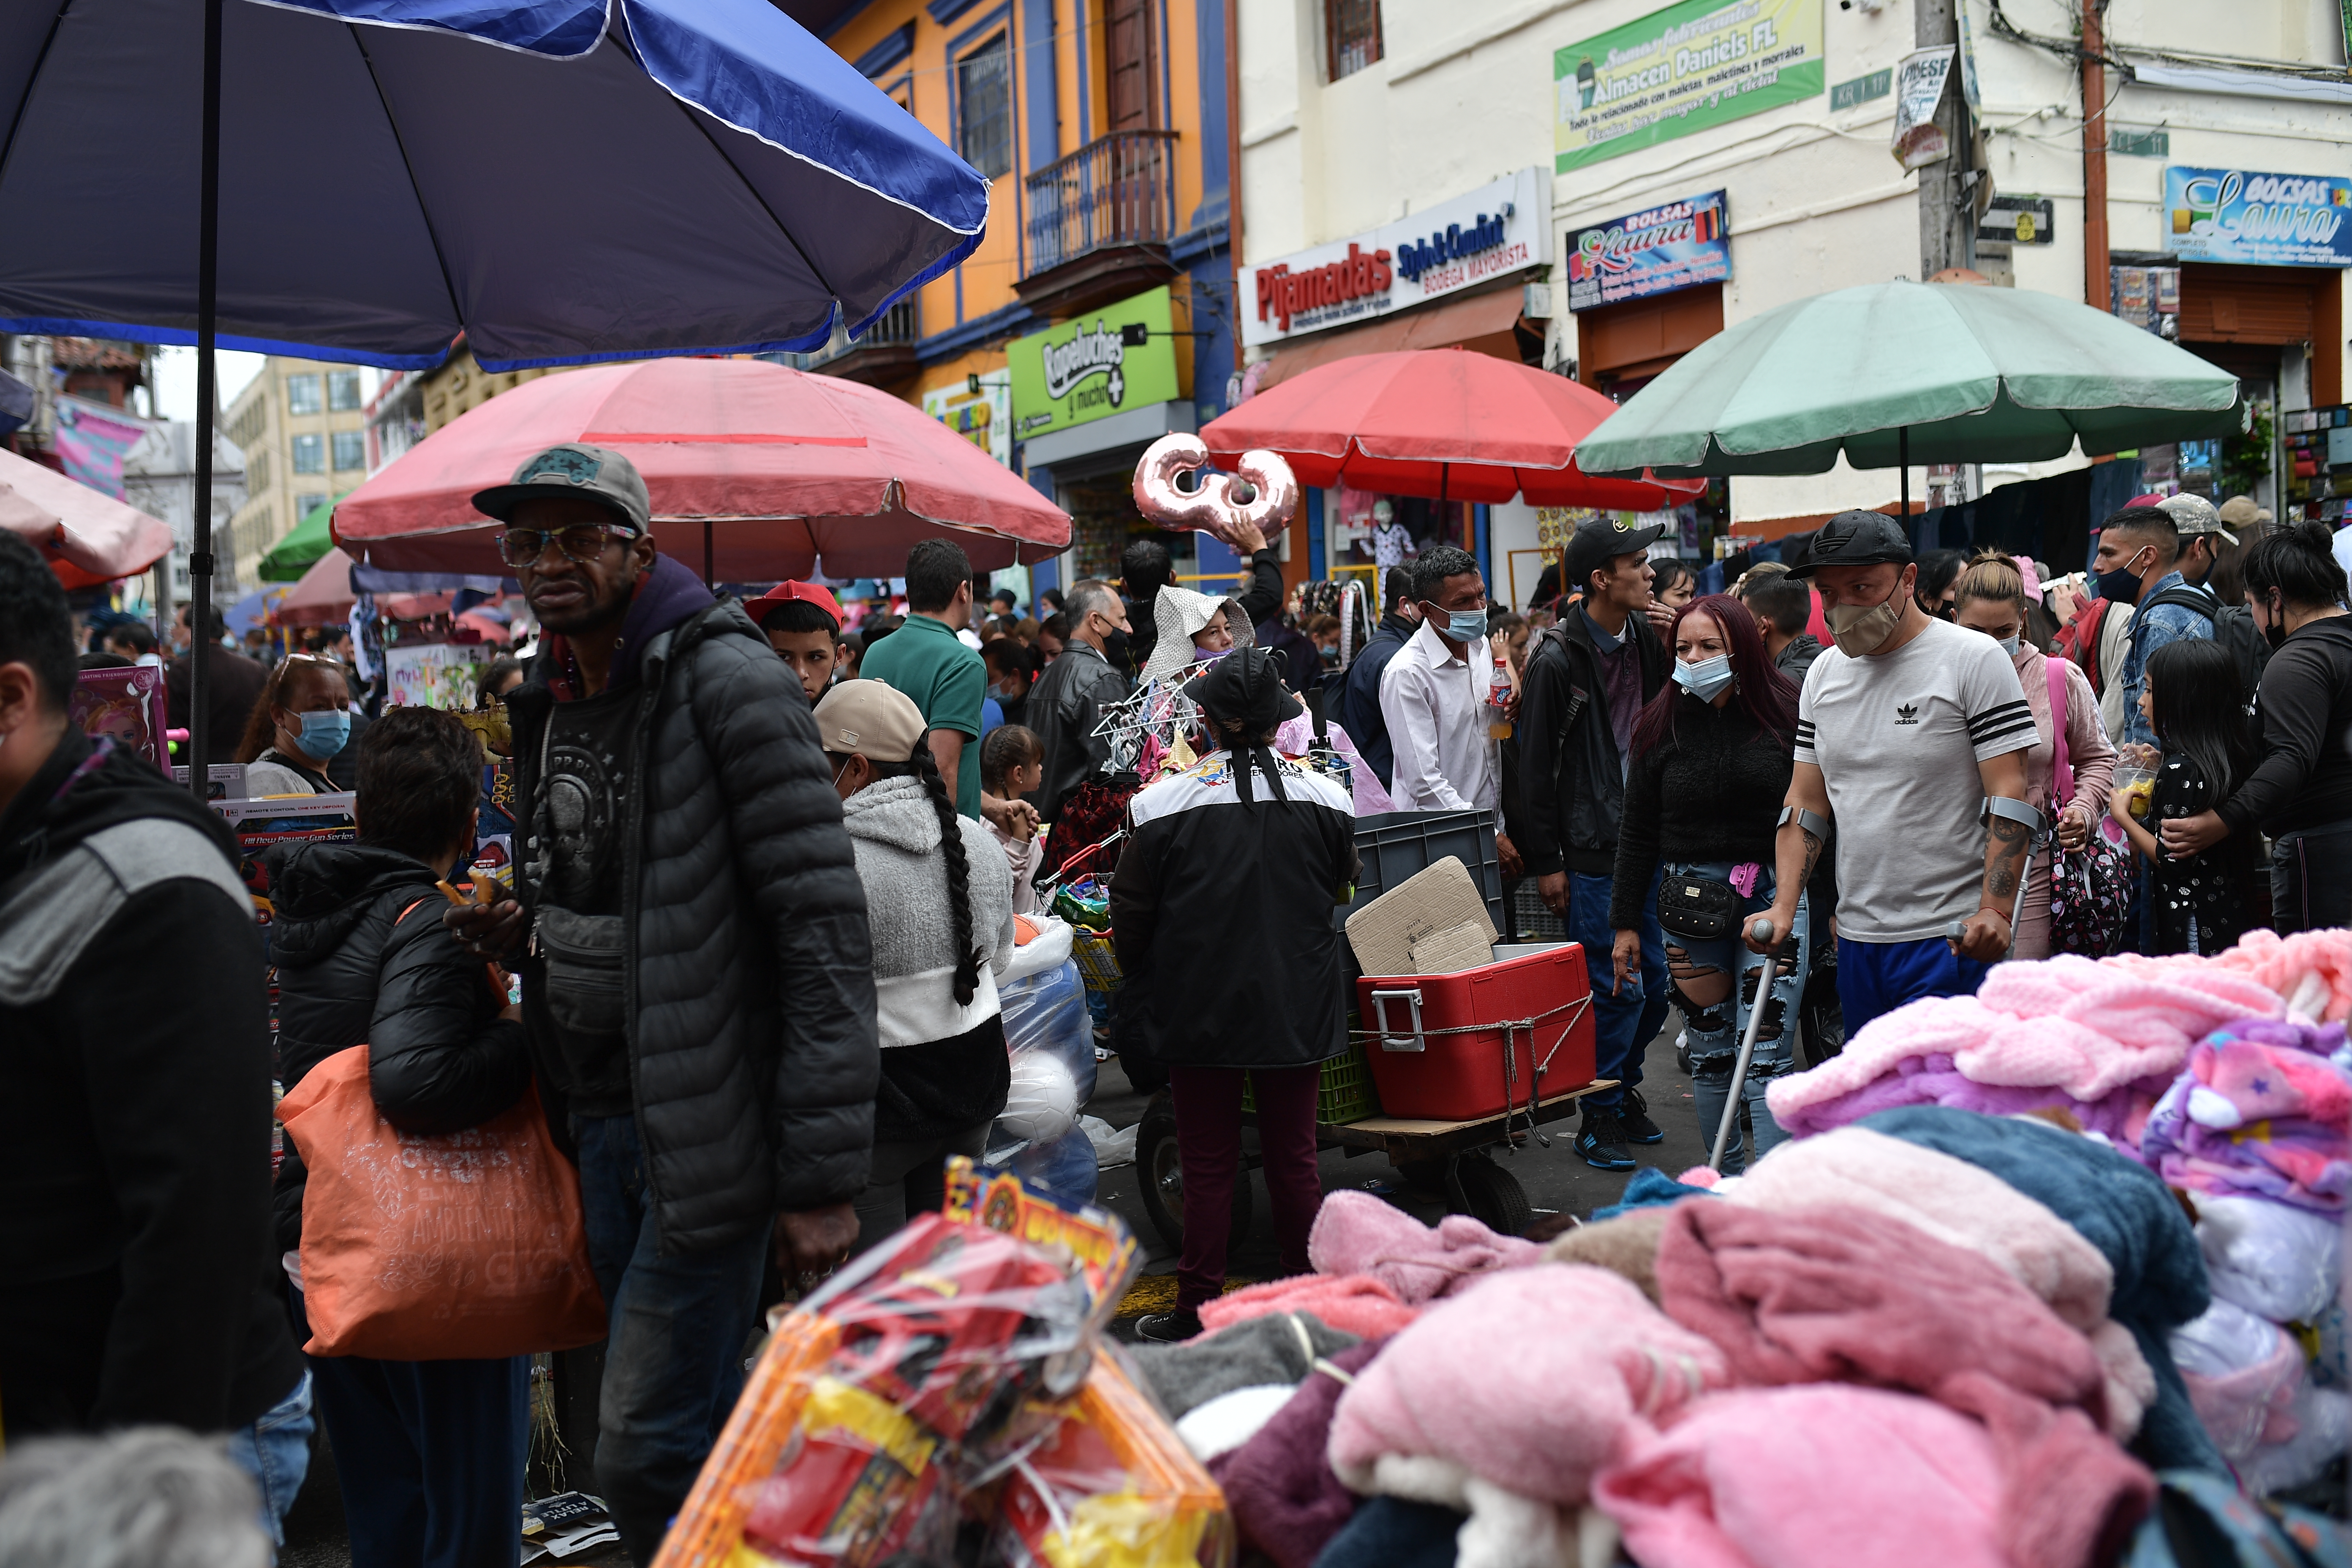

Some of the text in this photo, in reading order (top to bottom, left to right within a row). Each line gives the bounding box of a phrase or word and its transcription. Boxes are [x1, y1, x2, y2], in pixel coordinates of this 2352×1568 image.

[1592, 18, 1778, 106] Almacen Daniels FL
[1651, 92, 1665, 103] con
[1708, 63, 1751, 84] maletines
[1753, 61, 1759, 72] y
[1762, 44, 1805, 66] morrales
[1661, 95, 1708, 119] mayor
[1710, 90, 1720, 109] y
[1724, 80, 1739, 100] al
[1839, 85, 1854, 105] KR
[2152, 136, 2162, 153] 11
[1625, 200, 1694, 232] BOLSAS
[2185, 171, 2342, 244] Laura
[1579, 219, 1695, 272] Laura
[1424, 243, 1528, 294] BODEGA MAYORISTA
[327, 832, 354, 840] Series
[540, 1503, 578, 1518] LITTLE
[550, 1505, 589, 1520] RELAX
